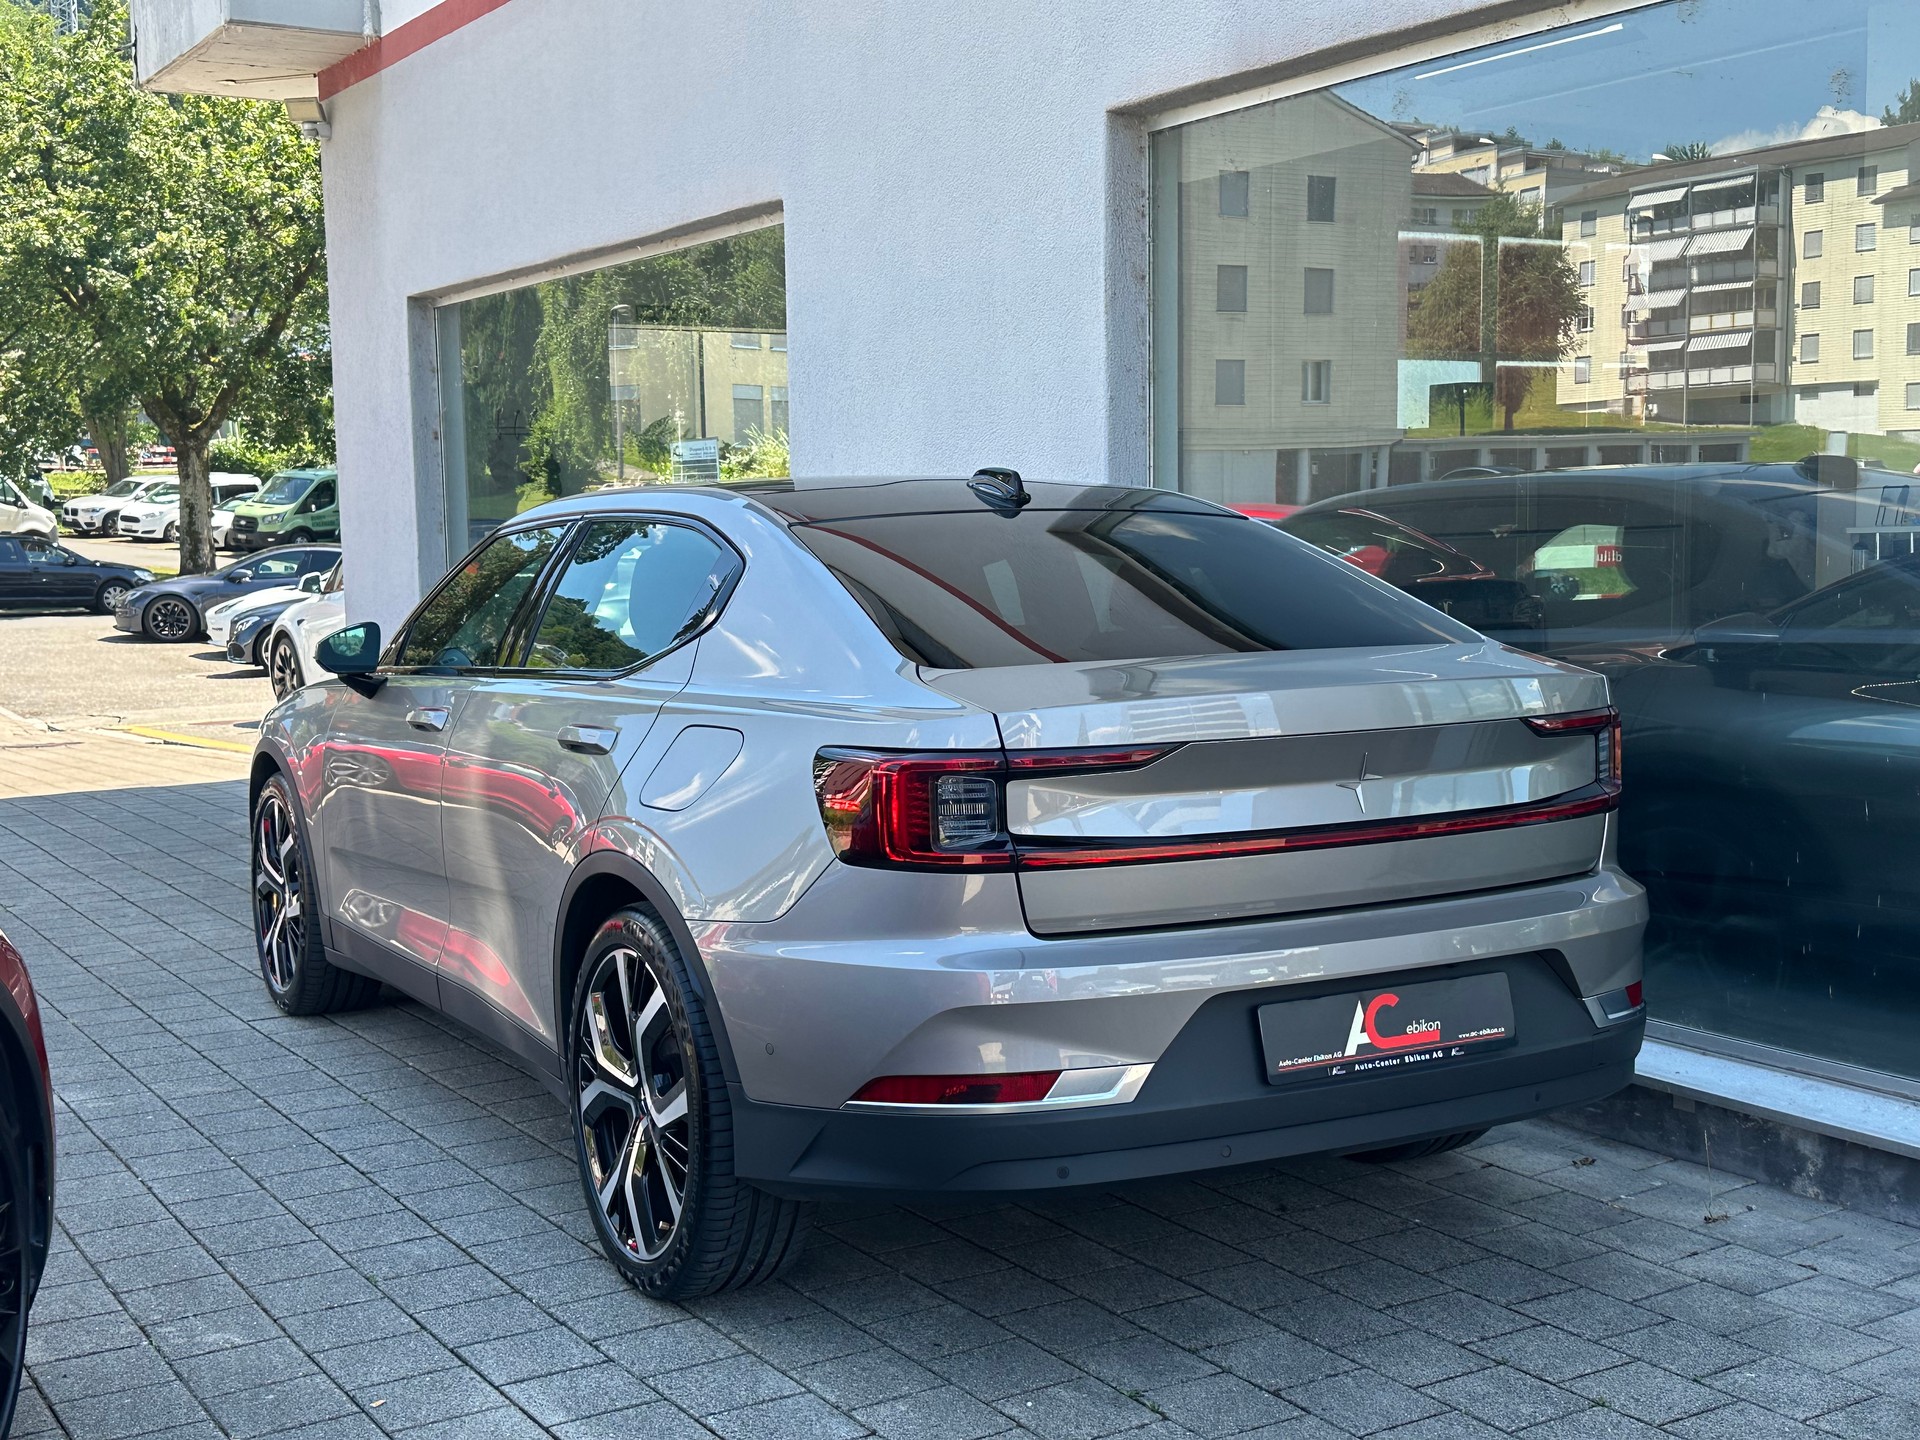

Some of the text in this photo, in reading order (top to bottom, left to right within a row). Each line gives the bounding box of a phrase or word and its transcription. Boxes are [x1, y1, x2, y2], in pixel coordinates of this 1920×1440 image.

[1344, 993, 1441, 1057] AC ebikon
[1278, 1050, 1343, 1067] Auto-Center Ebikon AG
[1354, 1058, 1401, 1071] Auto-Center
[1404, 1053, 1430, 1063] Ebikon
[1432, 1050, 1444, 1059] AG
